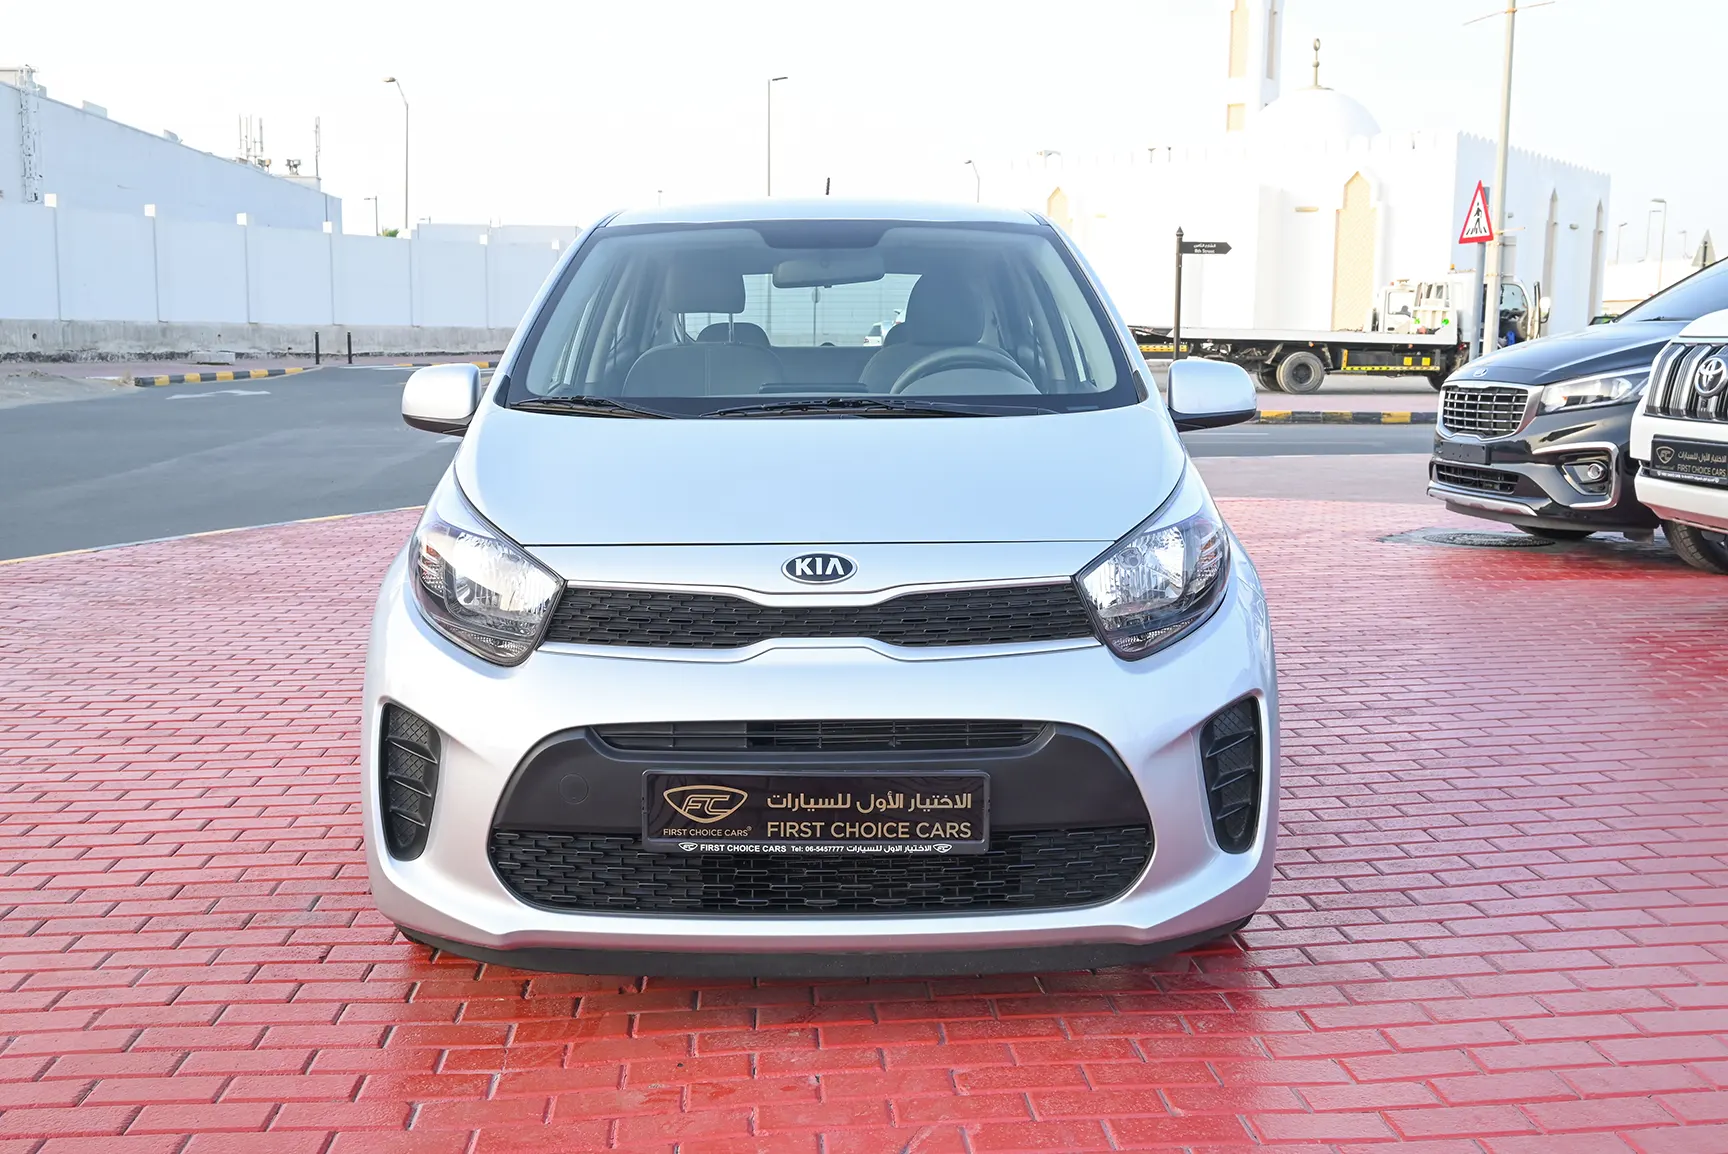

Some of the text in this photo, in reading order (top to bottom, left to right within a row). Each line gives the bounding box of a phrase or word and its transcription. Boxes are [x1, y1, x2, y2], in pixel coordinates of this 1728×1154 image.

[1677, 464, 1691, 473] FIRST
[1691, 465, 1711, 476] CHOICE
[1711, 468, 1727, 477] CARS
[795, 557, 845, 576] KIA
[767, 790, 972, 814] الاختيار الأول للسيارات
[663, 828, 748, 837] FIRST CHOICE CARS
[767, 821, 972, 838] FIRST CHOICE CARS
[700, 844, 725, 852] FIRST
[726, 844, 760, 853] CHOICE
[762, 845, 787, 853] CARS
[846, 844, 882, 854] للسيارات
[903, 844, 932, 853] الاختيار
